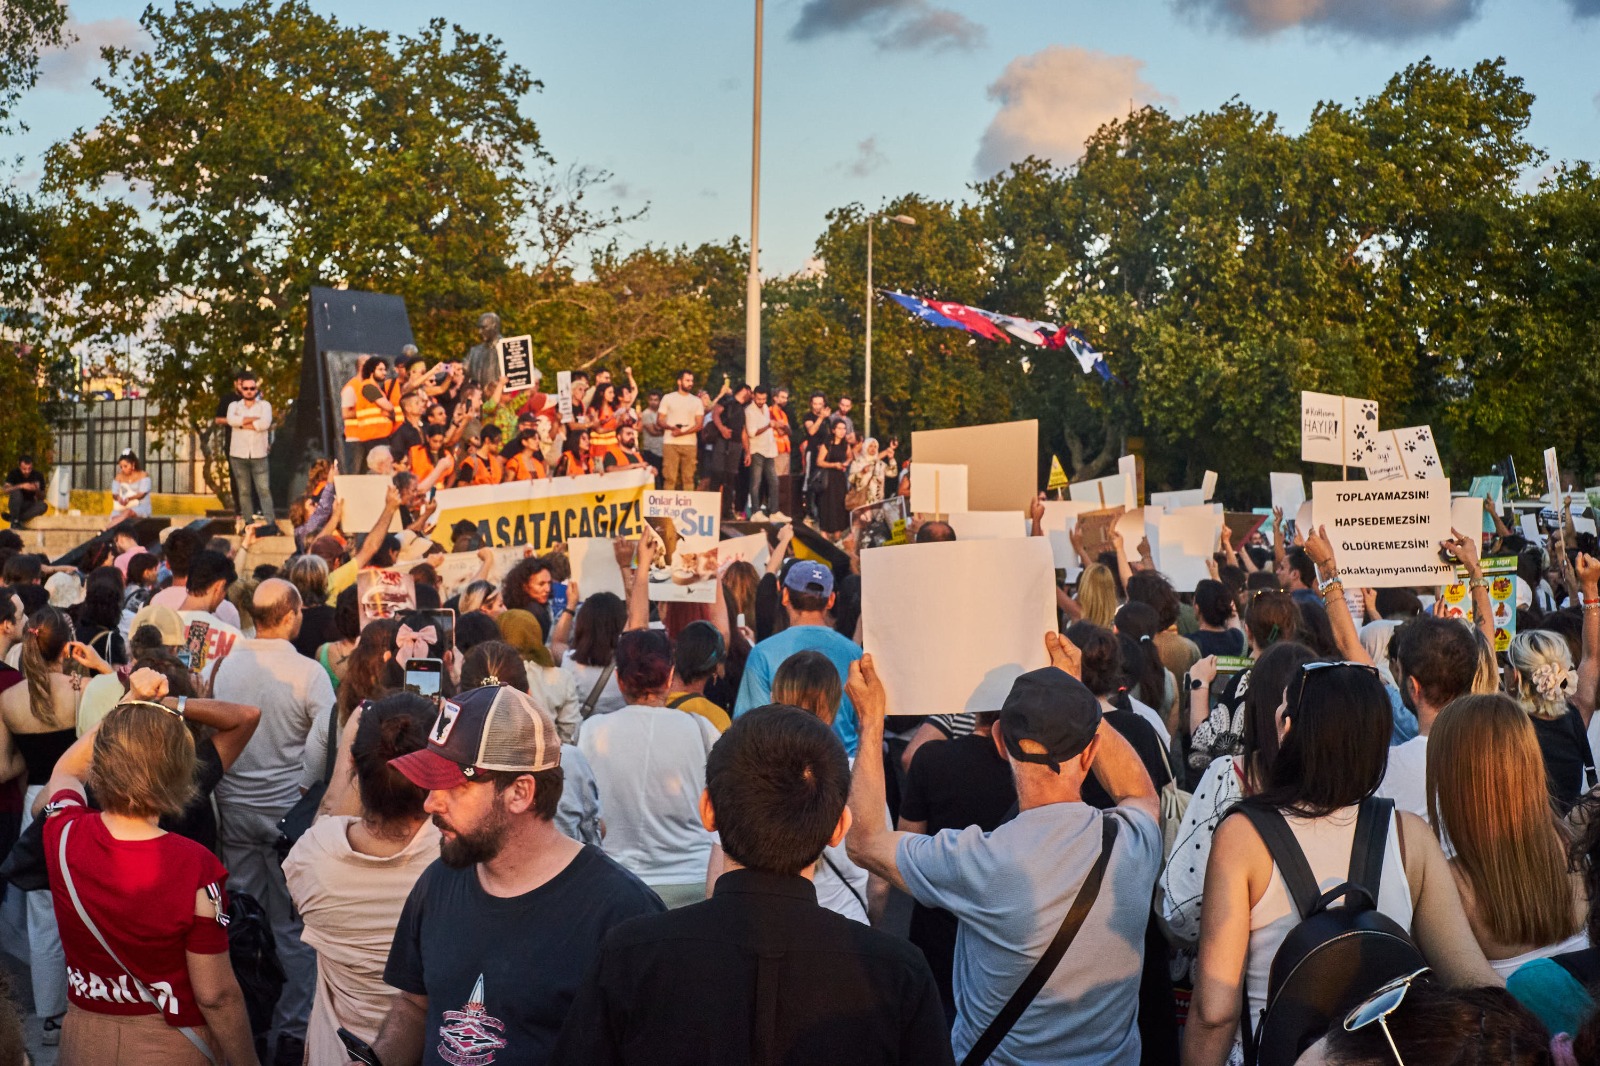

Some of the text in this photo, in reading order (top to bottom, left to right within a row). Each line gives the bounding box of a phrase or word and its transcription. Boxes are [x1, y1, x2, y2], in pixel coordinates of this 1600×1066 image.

[649, 495, 673, 506] Onlar
[1336, 490, 1429, 502] TOPLAYAMAZSIN!
[650, 507, 714, 536] Bir Kap Su
[1335, 514, 1430, 527] HAPSEDEMEZSİN!
[1342, 539, 1429, 551] ÖLDÜREMEZSİN!
